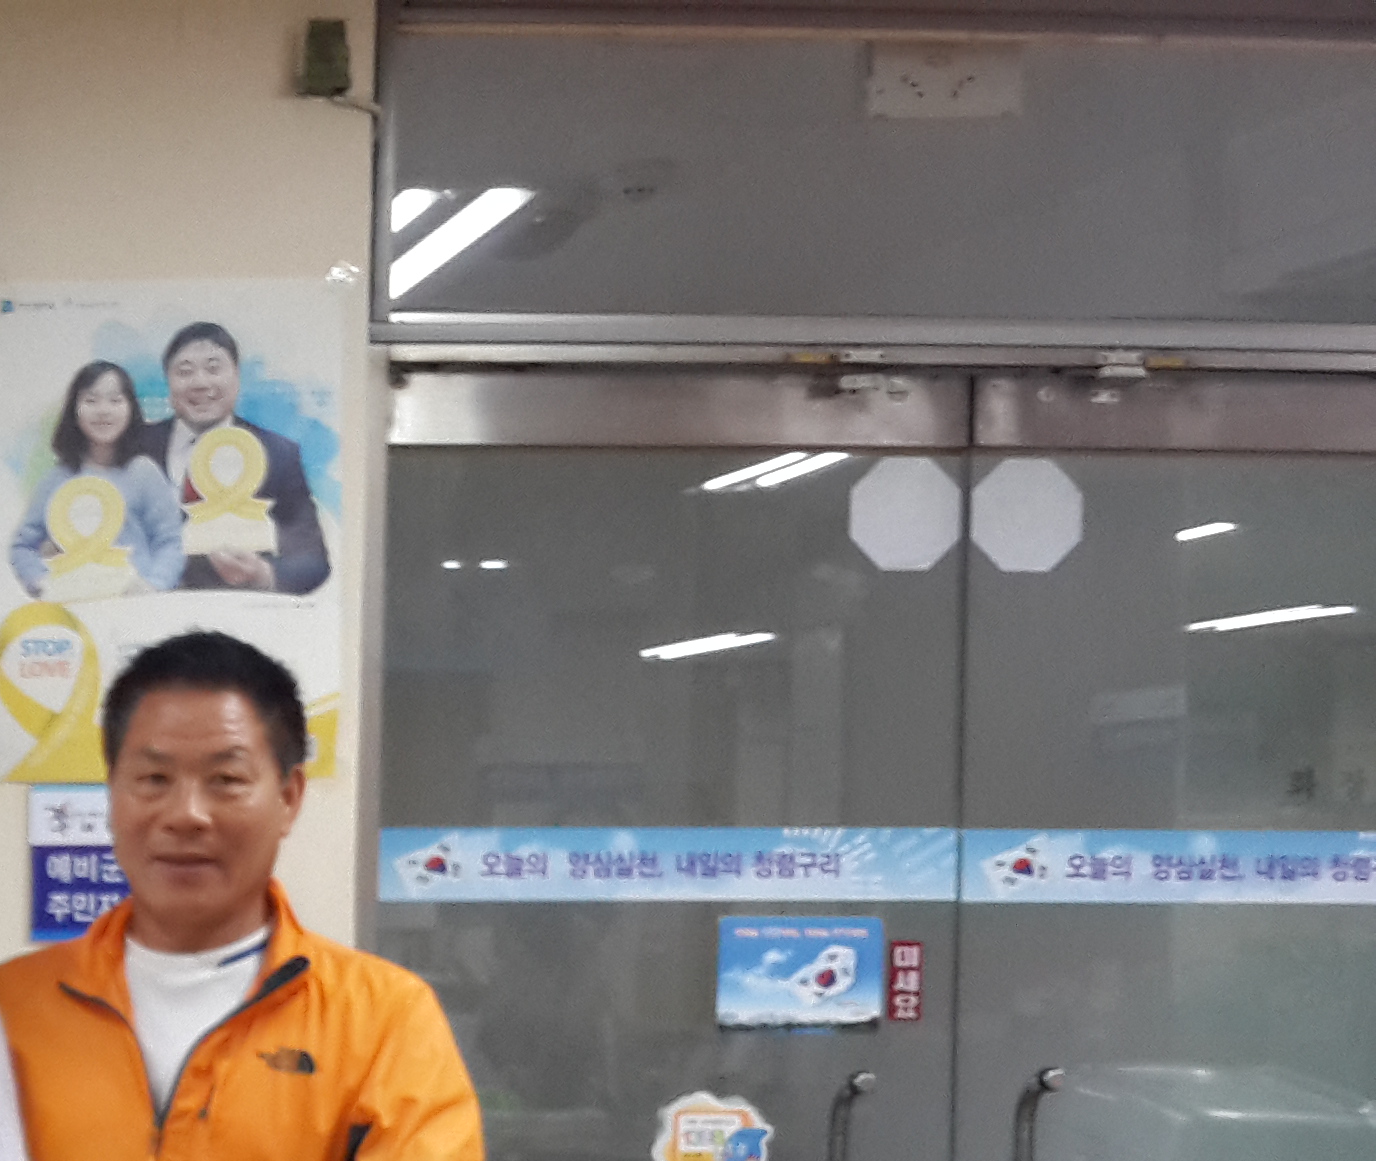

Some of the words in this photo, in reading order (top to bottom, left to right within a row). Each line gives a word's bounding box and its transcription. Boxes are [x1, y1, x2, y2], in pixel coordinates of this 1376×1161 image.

[21, 638, 73, 657] STOP
[19, 660, 71, 680] LOVE
[480, 851, 547, 880] 오늘의
[675, 851, 743, 879] 내일의
[752, 851, 842, 880] 청렴구리
[1065, 853, 1133, 882] 오늘의
[1256, 854, 1321, 882] 내일의
